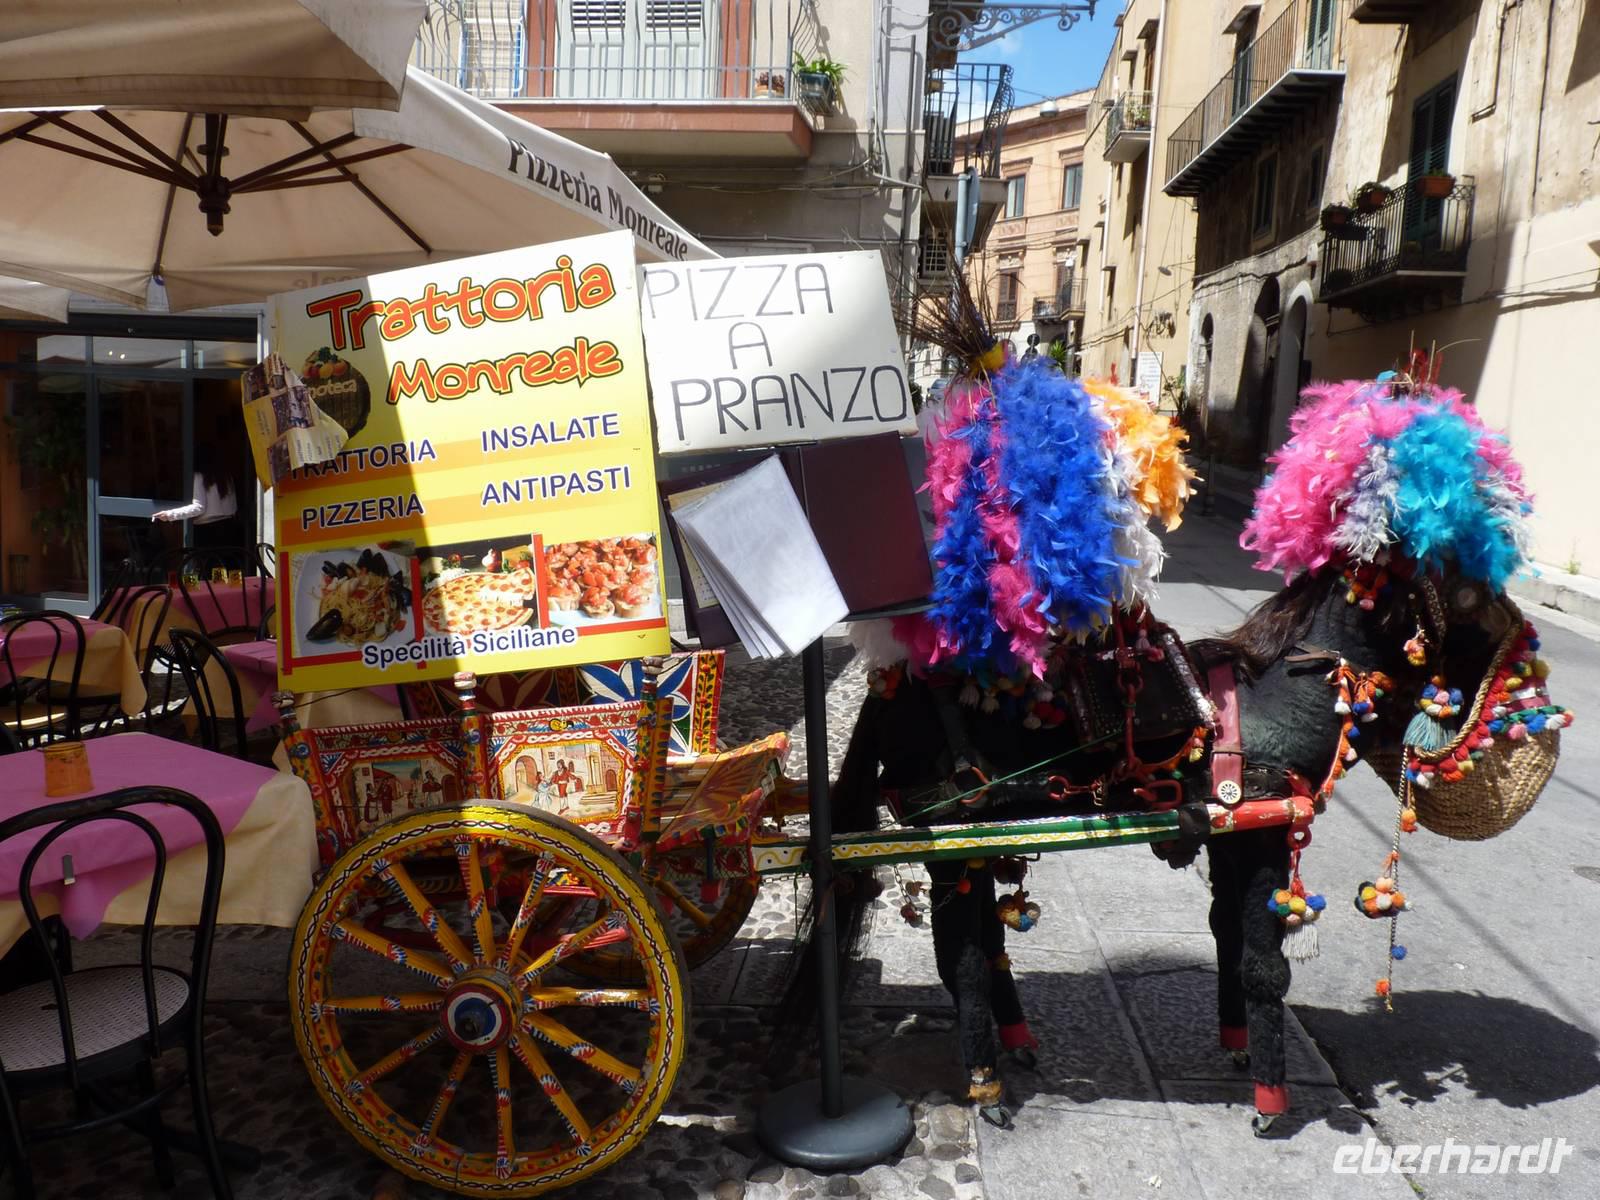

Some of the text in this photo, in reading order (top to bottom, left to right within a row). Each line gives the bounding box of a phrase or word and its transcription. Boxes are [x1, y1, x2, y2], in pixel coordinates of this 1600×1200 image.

[507, 136, 688, 261] Pizzeria Monreale
[307, 254, 618, 351] Trattoria
[644, 262, 834, 321] PIZZA
[728, 321, 773, 370] A
[309, 379, 357, 398] noteca
[386, 336, 623, 405] Monreale
[670, 365, 907, 441] PRANZO
[482, 413, 620, 452] INSALATE
[482, 466, 631, 506] ANTIPASTI
[302, 493, 424, 530] PIZZERIA
[362, 628, 576, 669] Specilità Siciliane
